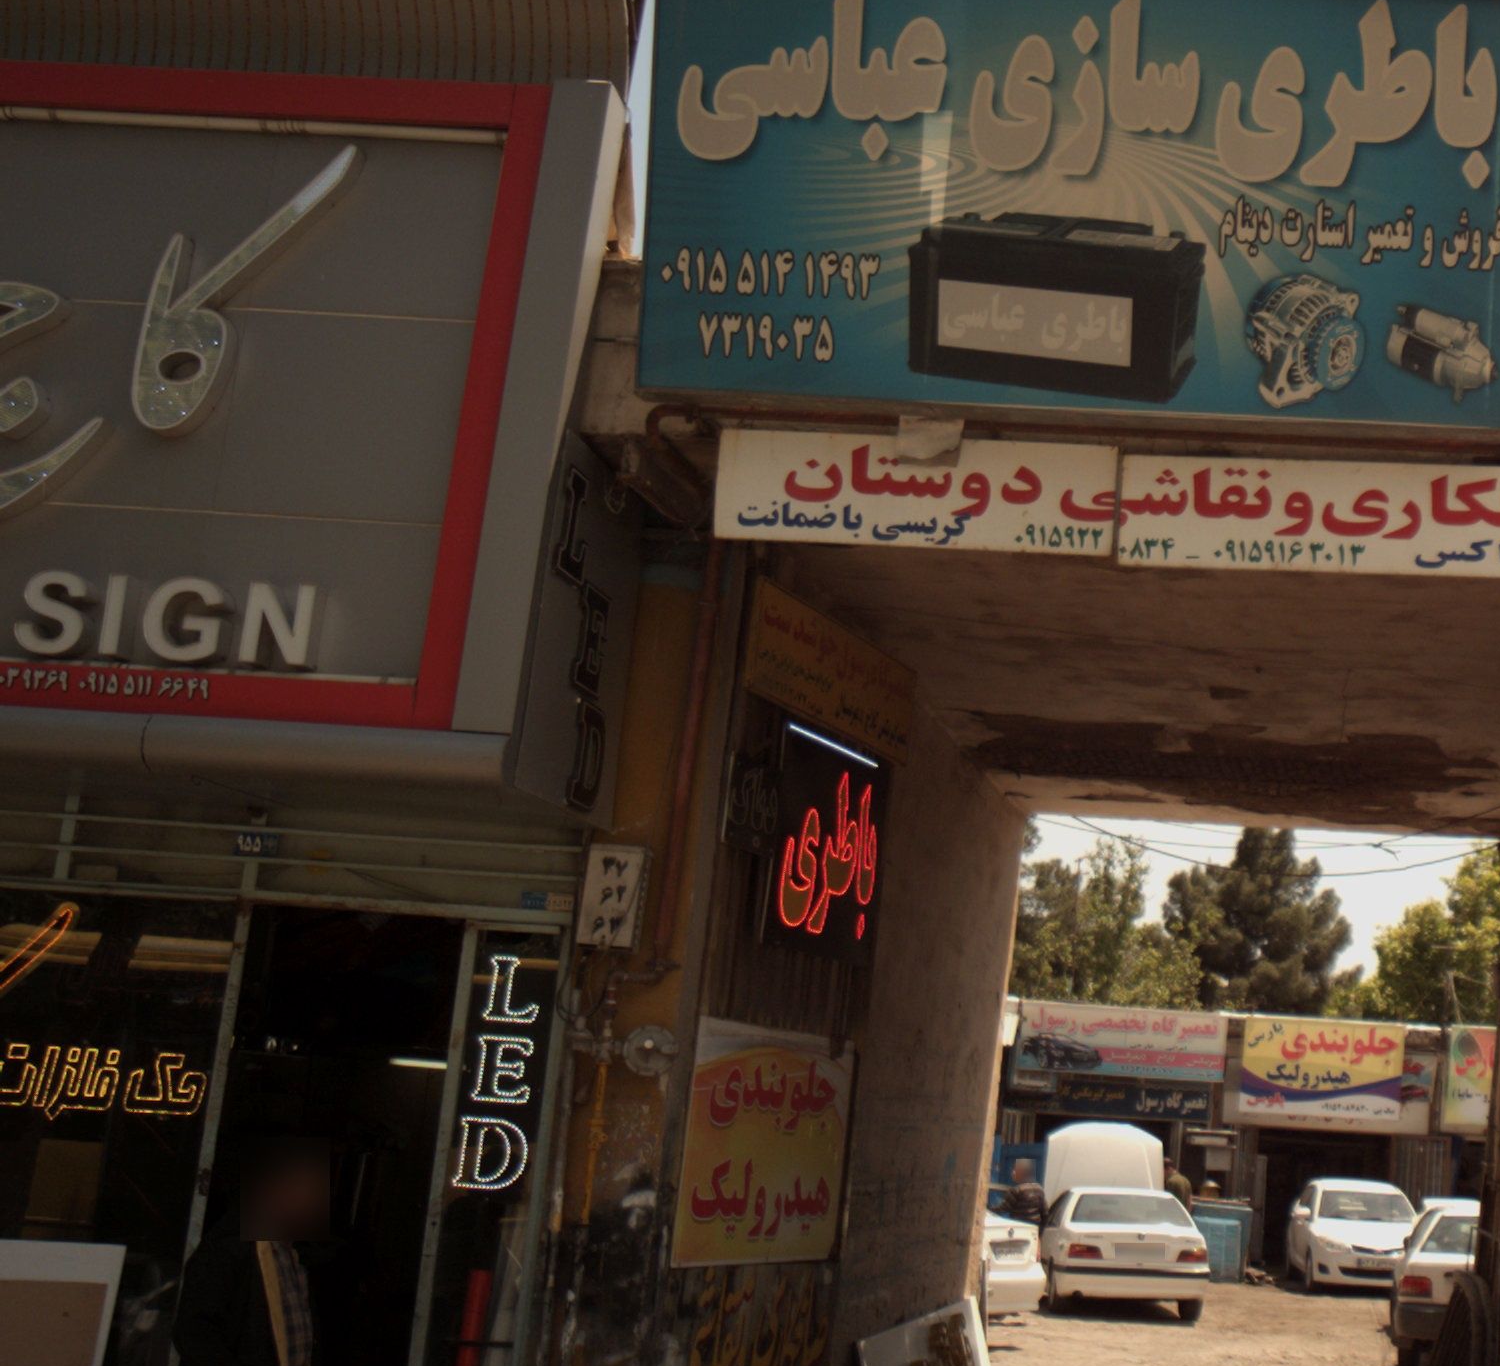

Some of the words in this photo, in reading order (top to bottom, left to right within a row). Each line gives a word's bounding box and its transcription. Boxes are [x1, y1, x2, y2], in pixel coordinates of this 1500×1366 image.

[1218, 193, 1275, 259] دینام
[1280, 198, 1357, 263] استارت
[1360, 204, 1415, 266] تعمیر
[1418, 223, 1435, 268] و
[660, 245, 729, 296] ۰۹۱۵
[804, 249, 881, 301] ۱۴۹۳
[698, 311, 835, 363] ۷۳۱۹۰۳۵
[941, 290, 1025, 344] عباسی
[1040, 299, 1128, 354] باطری
[783, 444, 1042, 517] دوستان
[12, 570, 318, 671] SIGN
[778, 771, 878, 941] باطری
[1265, 1062, 1352, 1090] هیدرولیک
[1280, 1026, 1400, 1066] جلوبندی
[709, 1059, 837, 1135] جلوبندی
[690, 1157, 832, 1242] هیدرولیک
